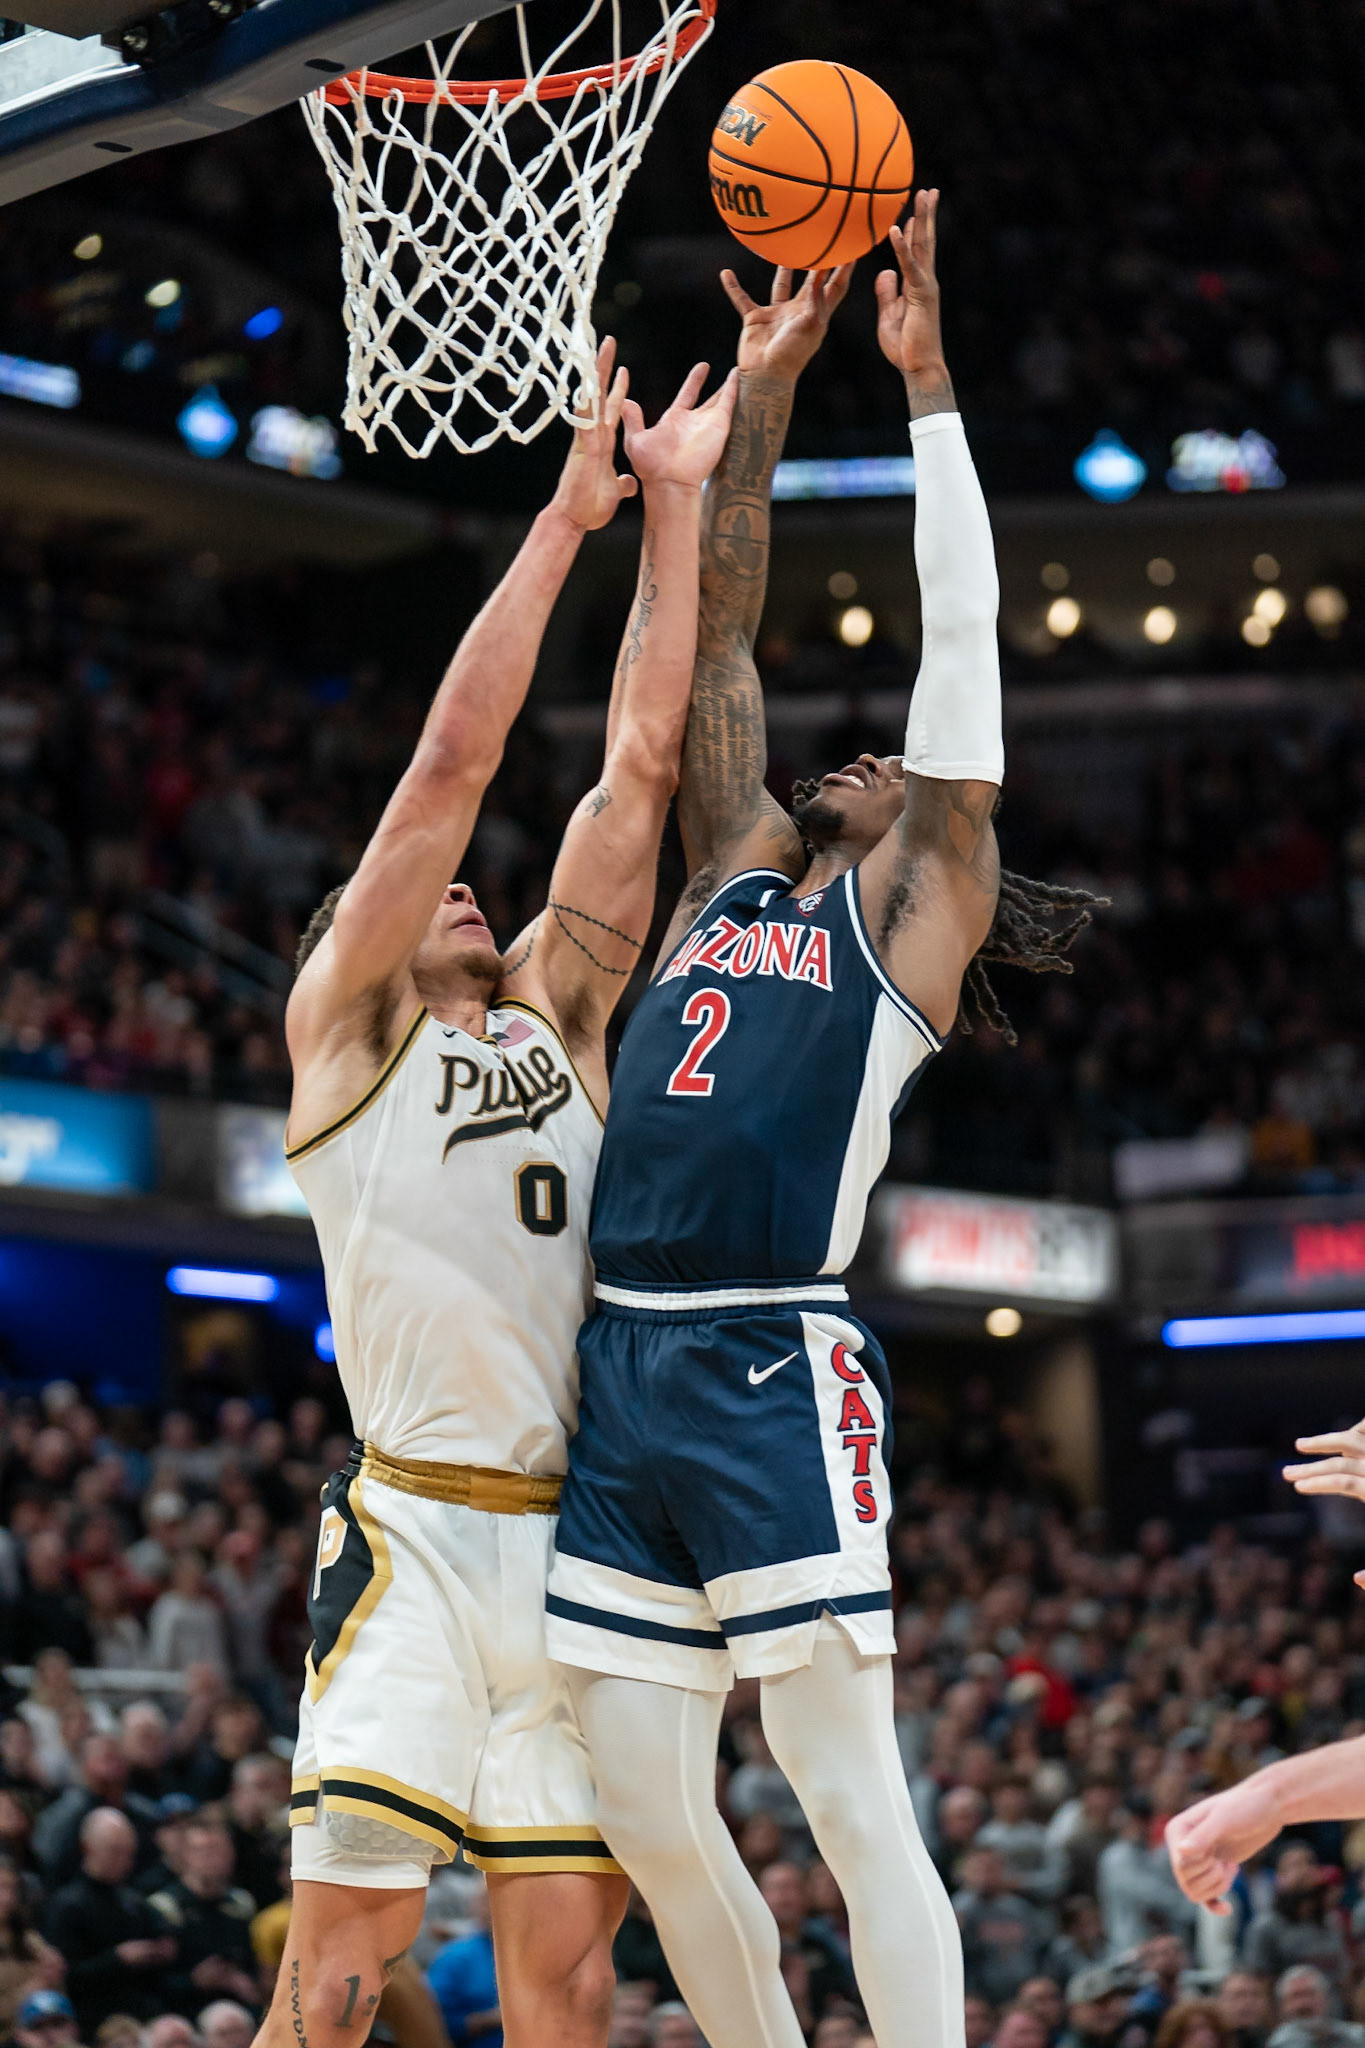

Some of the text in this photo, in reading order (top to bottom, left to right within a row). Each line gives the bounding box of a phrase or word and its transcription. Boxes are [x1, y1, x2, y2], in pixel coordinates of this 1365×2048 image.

[656, 914, 834, 992] AZONA
[666, 987, 731, 1096] 2
[513, 1161, 568, 1237] 0
[831, 1341, 878, 1523] CATS
[312, 1505, 349, 1601] P
